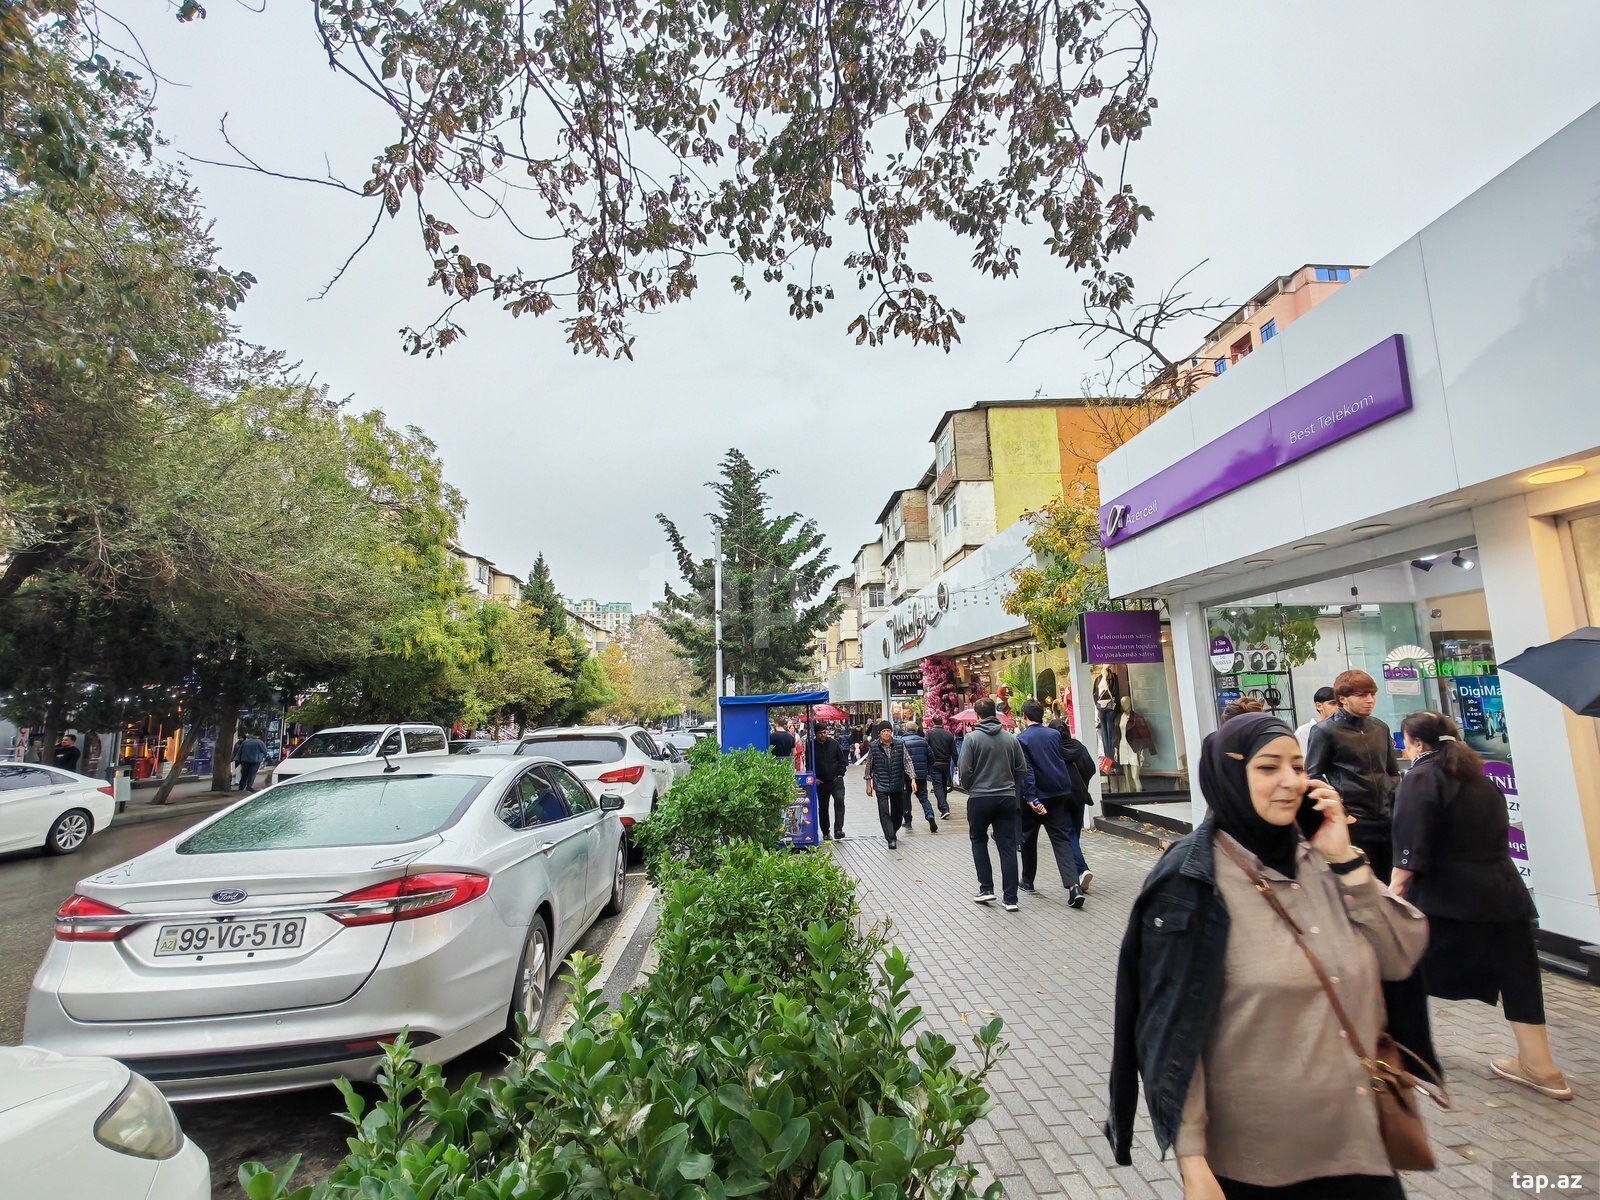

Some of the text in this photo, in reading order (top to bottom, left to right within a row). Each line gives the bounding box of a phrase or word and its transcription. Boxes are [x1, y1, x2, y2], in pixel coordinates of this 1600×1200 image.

[1289, 394, 1374, 444] Best Telekom
[1125, 499, 1158, 527] Azercell
[1384, 664, 1416, 679] Best
[216, 891, 239, 902] Ford
[160, 921, 298, 952] AZ 99-VG-518
